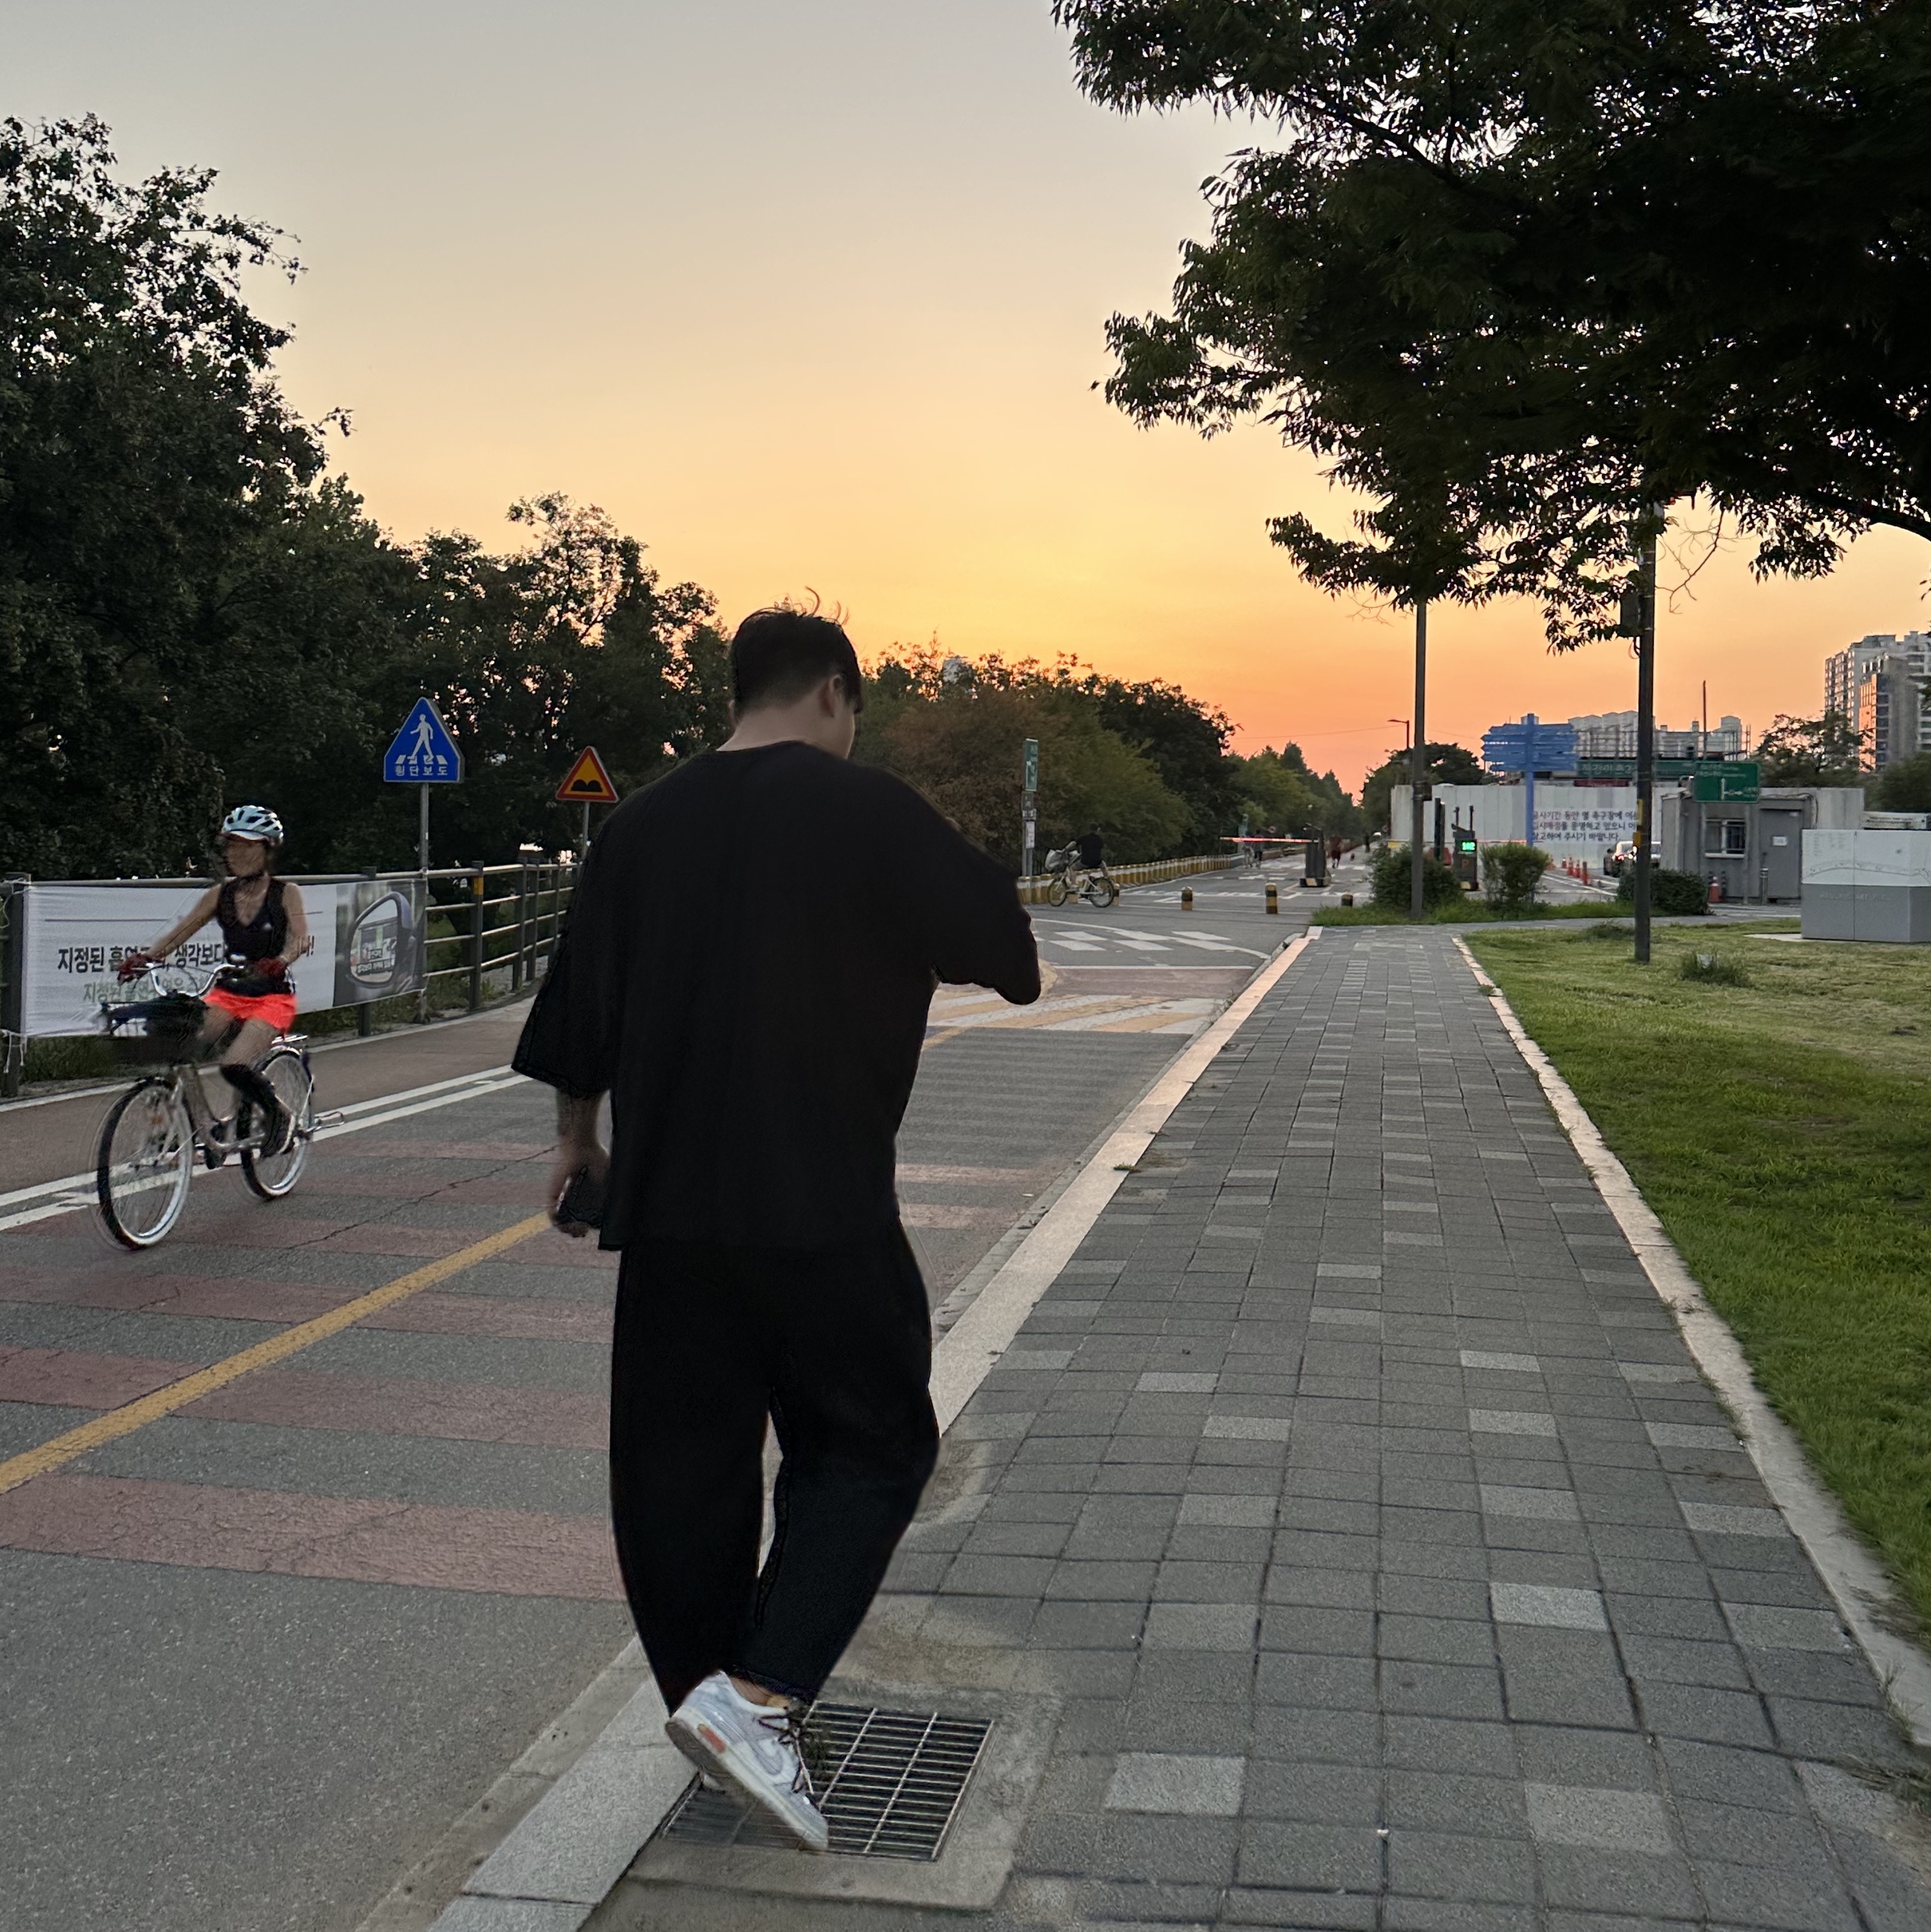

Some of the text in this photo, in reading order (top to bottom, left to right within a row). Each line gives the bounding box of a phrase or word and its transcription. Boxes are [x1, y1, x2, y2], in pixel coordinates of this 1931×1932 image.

[395, 764, 448, 777] 횡단보도
[1571, 821, 1600, 831] 운영하고
[1603, 821, 1626, 831] 있으니
[1564, 832, 1587, 842] 주시기
[57, 947, 104, 973] 지정된
